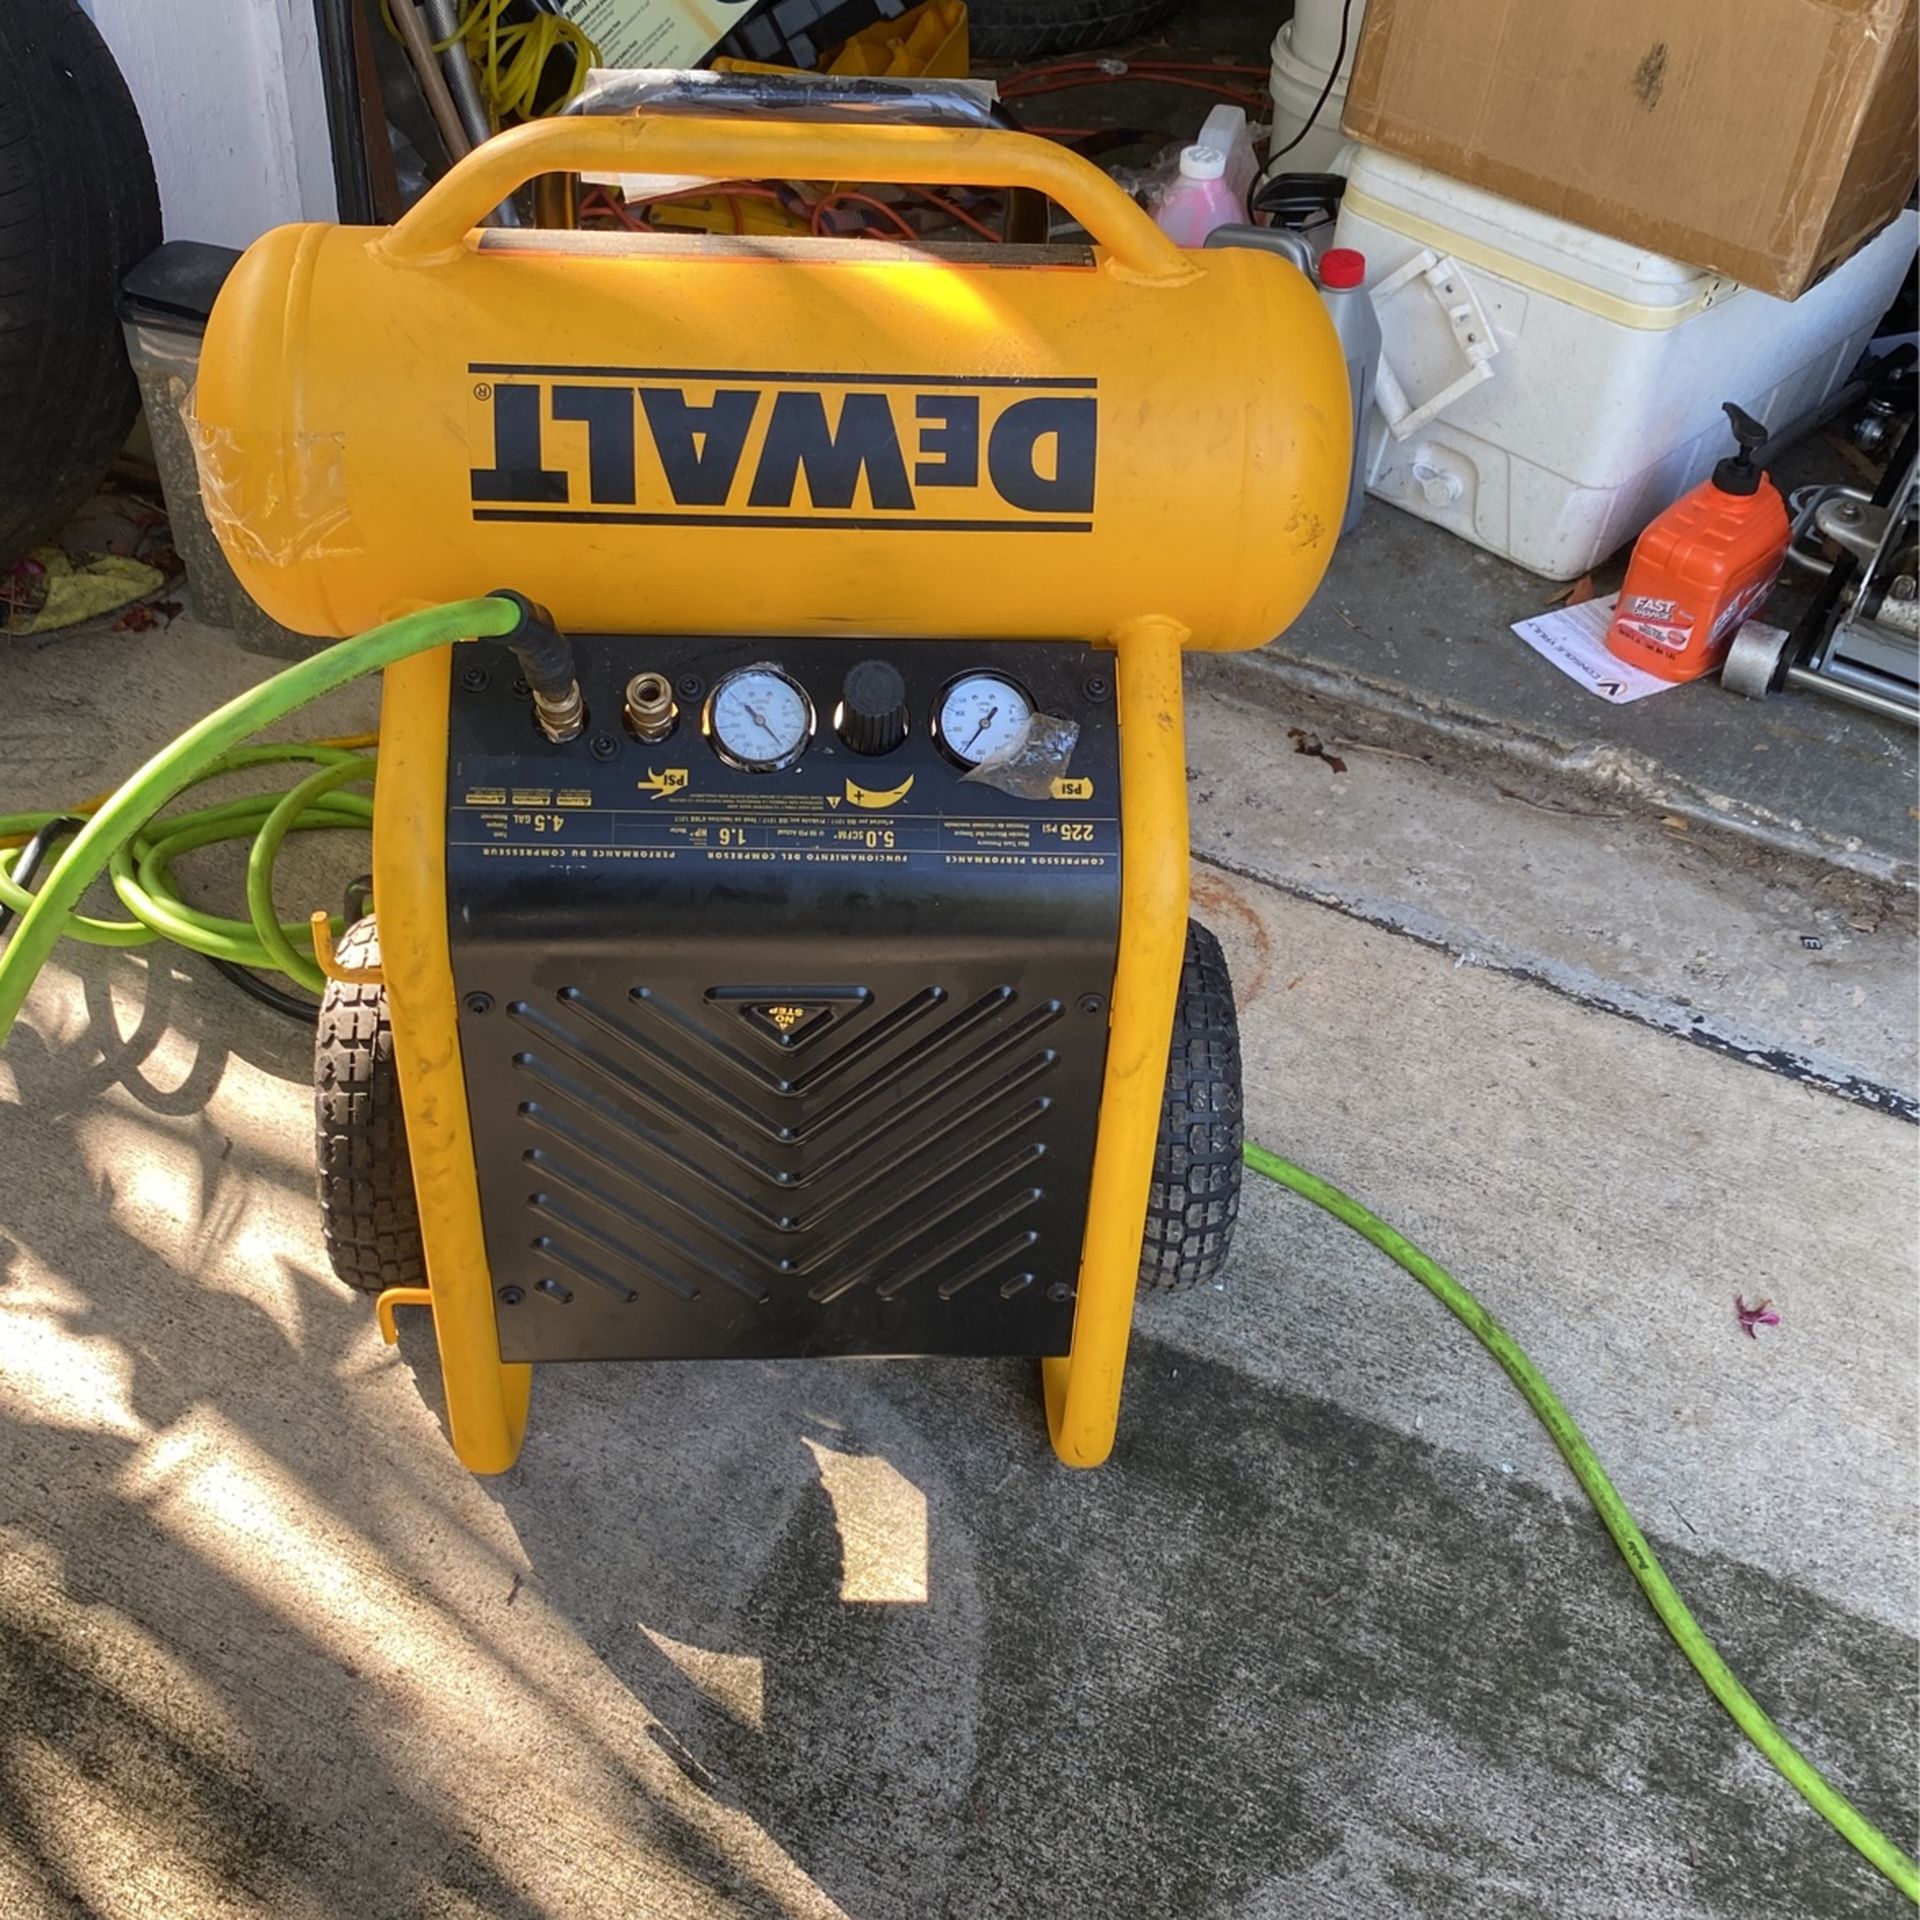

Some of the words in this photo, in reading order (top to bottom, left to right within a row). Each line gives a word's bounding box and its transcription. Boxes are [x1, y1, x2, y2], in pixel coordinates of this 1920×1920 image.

[470, 383, 1097, 513] DEWALT
[1634, 597, 1676, 612] FAST
[1557, 643, 1601, 680] CONSOLE
[664, 774, 684, 786] PSI
[1062, 783, 1082, 795] PSI
[513, 815, 531, 823] GAL
[535, 814, 564, 832] 4.5
[1042, 823, 1058, 833] PSI
[1061, 824, 1093, 841] 225
[719, 828, 746, 845] 1.6
[866, 831, 895, 848] 5.0
[482, 848, 566, 857] COMPRESSEUR
[571, 850, 587, 858] DU
[592, 850, 676, 859] PERFORMANCE
[707, 851, 776, 861] COMPRESOR
[781, 853, 801, 861] DEL
[807, 853, 908, 863] FUNCIONAMIENTO
[945, 856, 1026, 865] PERFORMANCE
[1031, 857, 1105, 866] COMPRESSOR
[769, 1007, 803, 1017] STEP
[775, 1015, 795, 1024] NO
